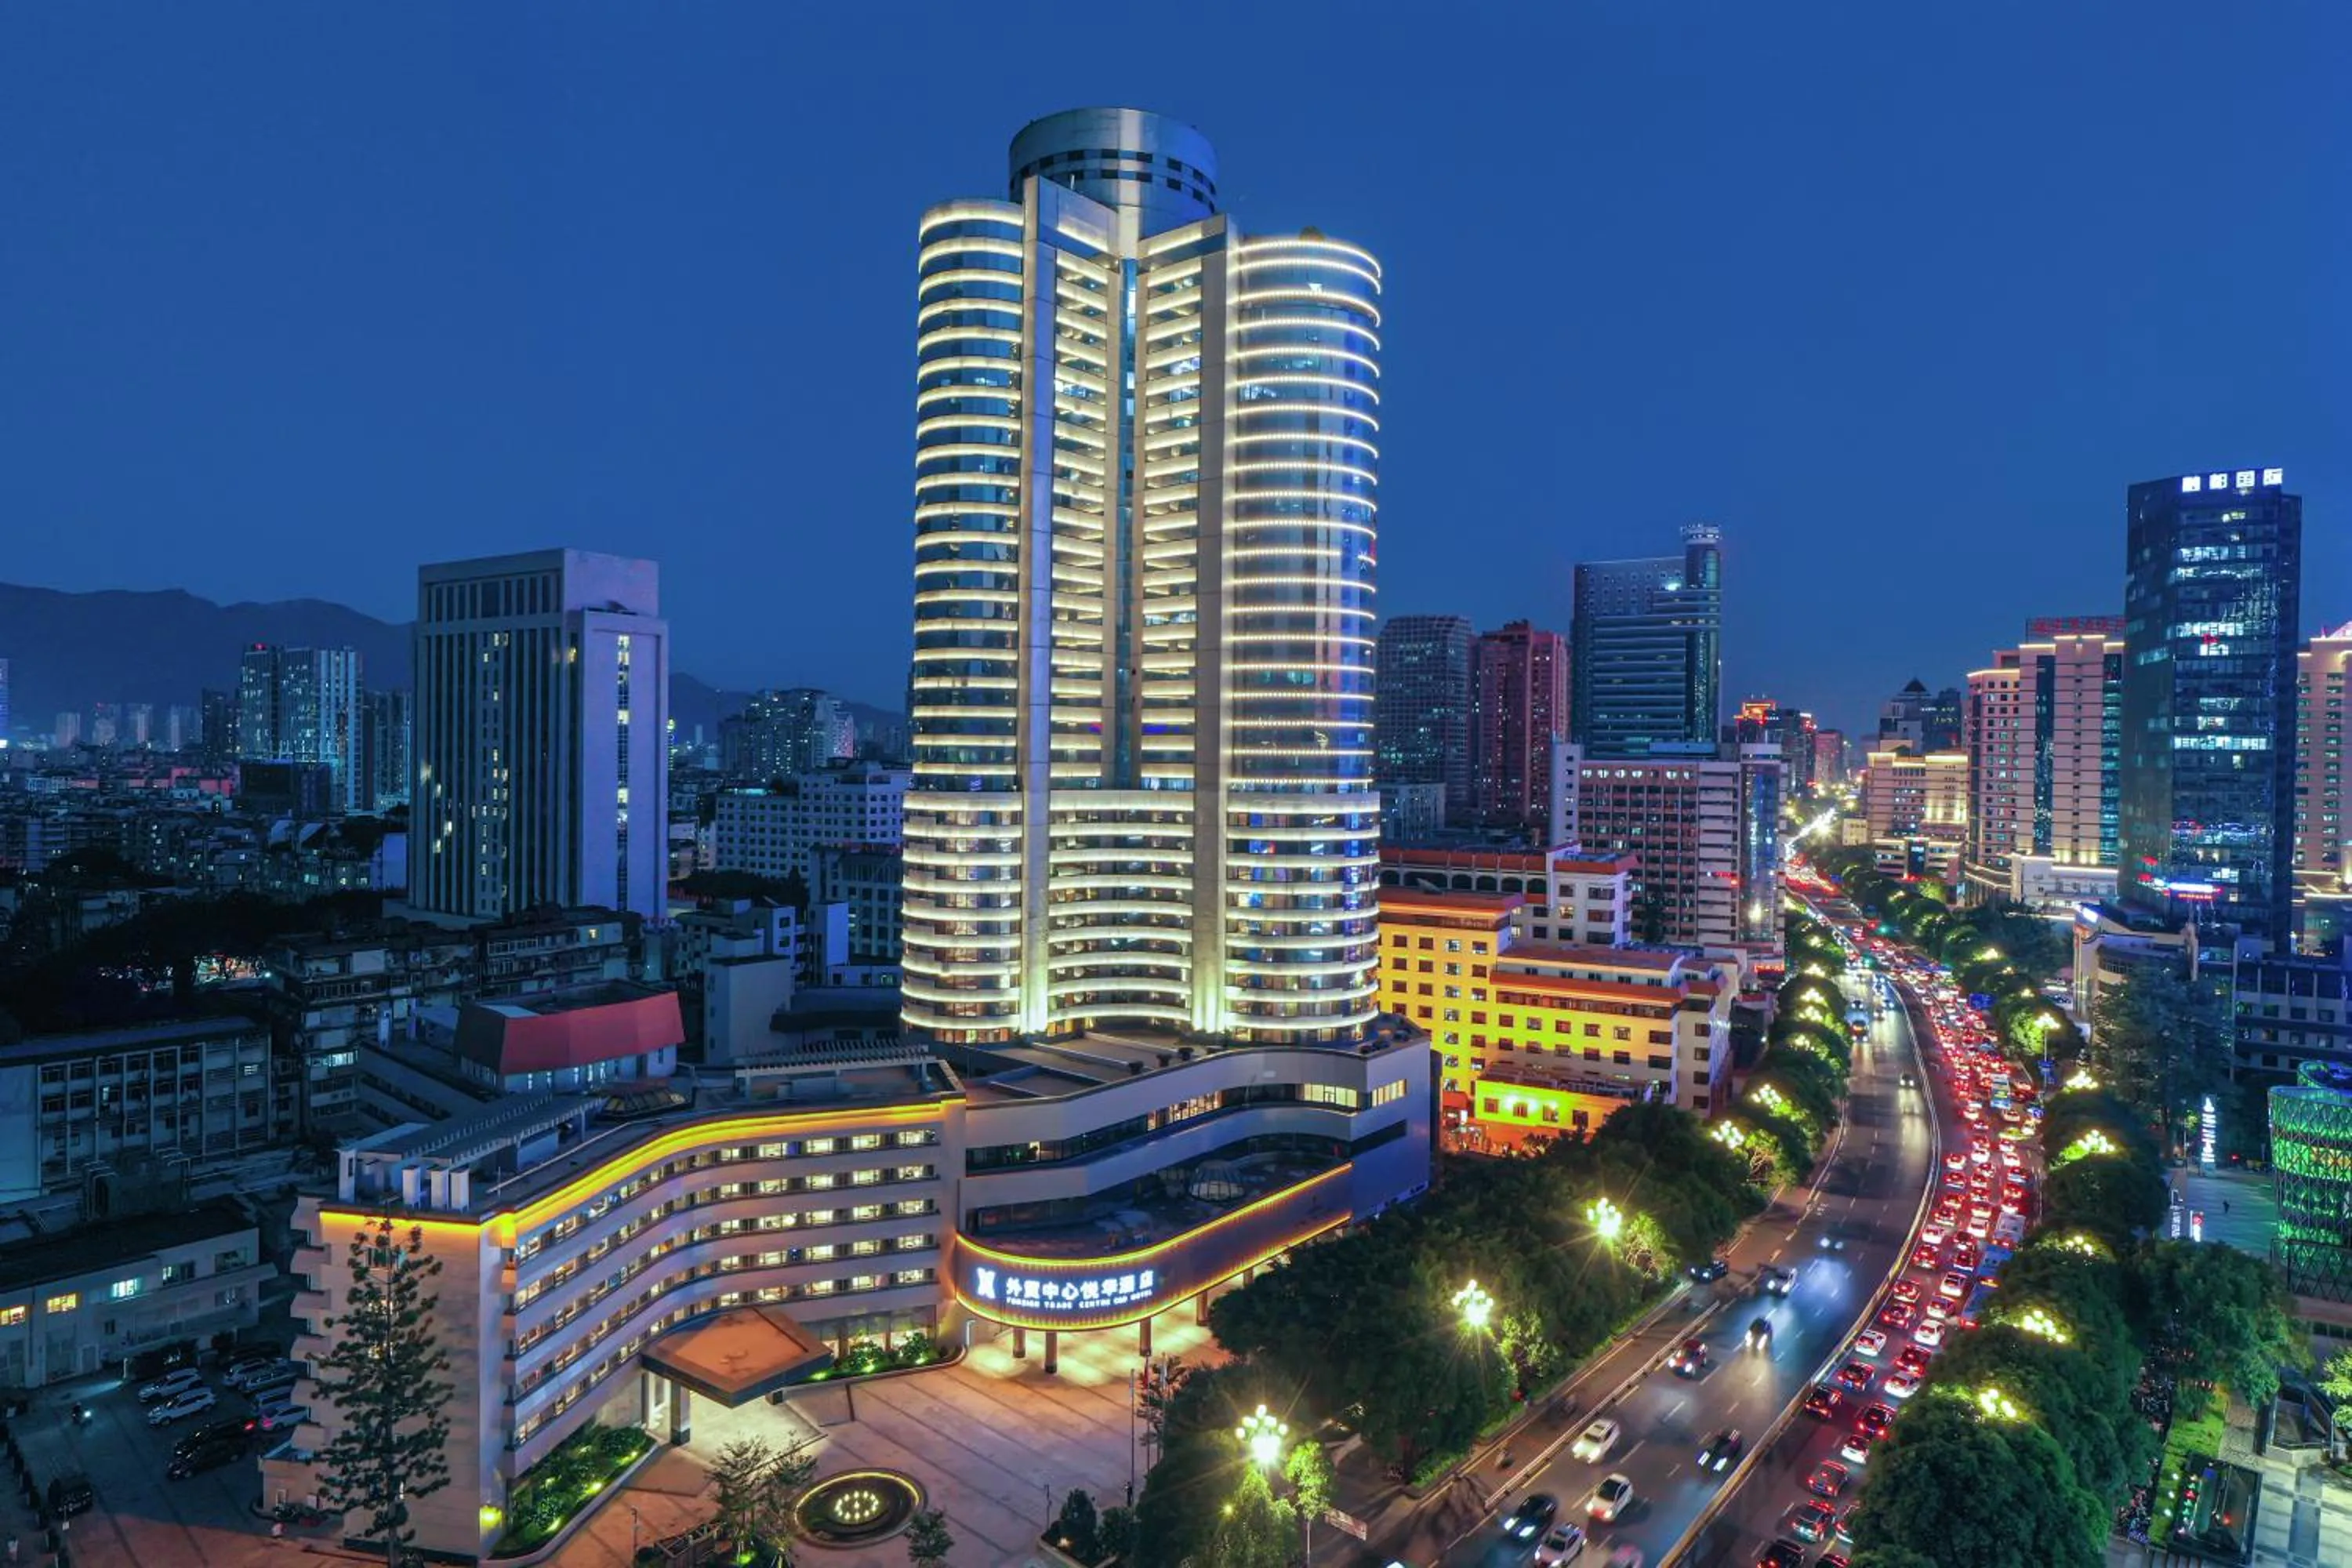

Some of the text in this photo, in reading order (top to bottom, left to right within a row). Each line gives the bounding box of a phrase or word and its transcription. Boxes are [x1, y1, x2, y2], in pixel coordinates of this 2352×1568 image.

[1006, 1270, 1154, 1300] 外贸中心悦华酒店
[1006, 1298, 1040, 1308] FOREIGN
[1130, 1290, 1152, 1301] HOTEL
